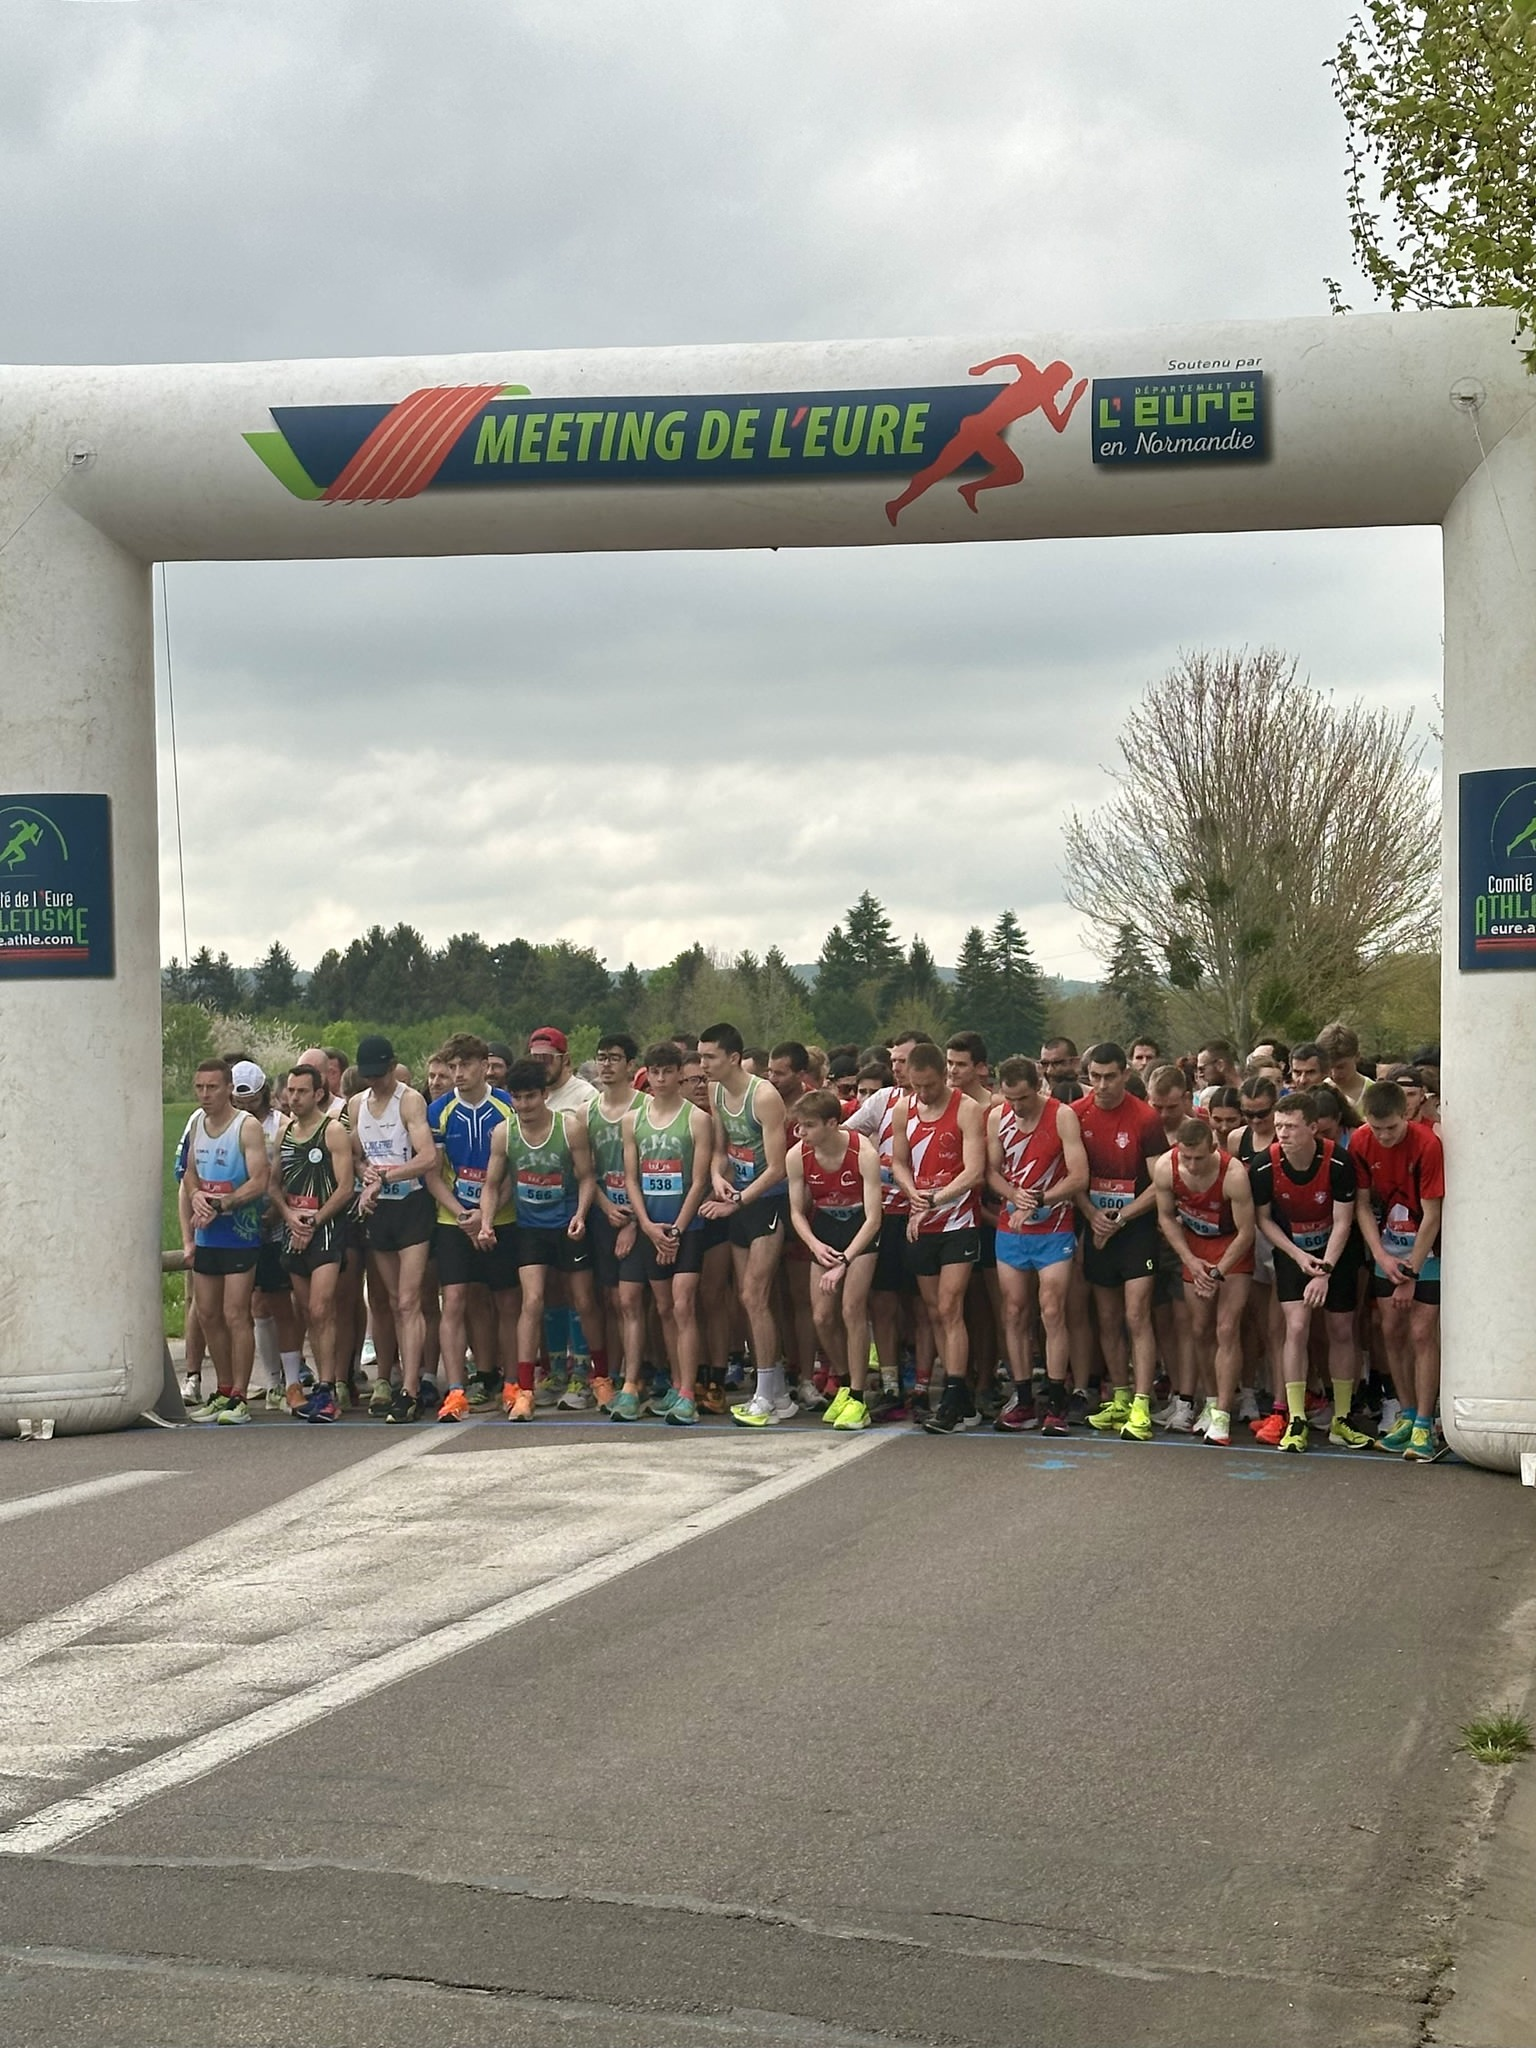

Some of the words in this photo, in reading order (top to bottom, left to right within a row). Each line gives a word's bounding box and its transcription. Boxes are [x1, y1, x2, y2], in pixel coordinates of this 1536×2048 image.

[1167, 359, 1231, 371] Soutenu
[1235, 357, 1263, 370] par
[1134, 382, 1232, 394] DÉPARTEMENT
[1240, 381, 1255, 389] DE
[473, 410, 688, 465] MEETING
[696, 408, 761, 461] DE
[768, 402, 930, 460] L'EURE
[1099, 440, 1127, 456] en
[1134, 427, 1256, 455] Normandie
[1488, 873, 1534, 894] Comité
[15, 891, 29, 907] de
[383, 1183, 400, 1195] 56
[649, 1178, 672, 1191] 538
[466, 1186, 482, 1199] 50
[1100, 1196, 1124, 1209] 600
